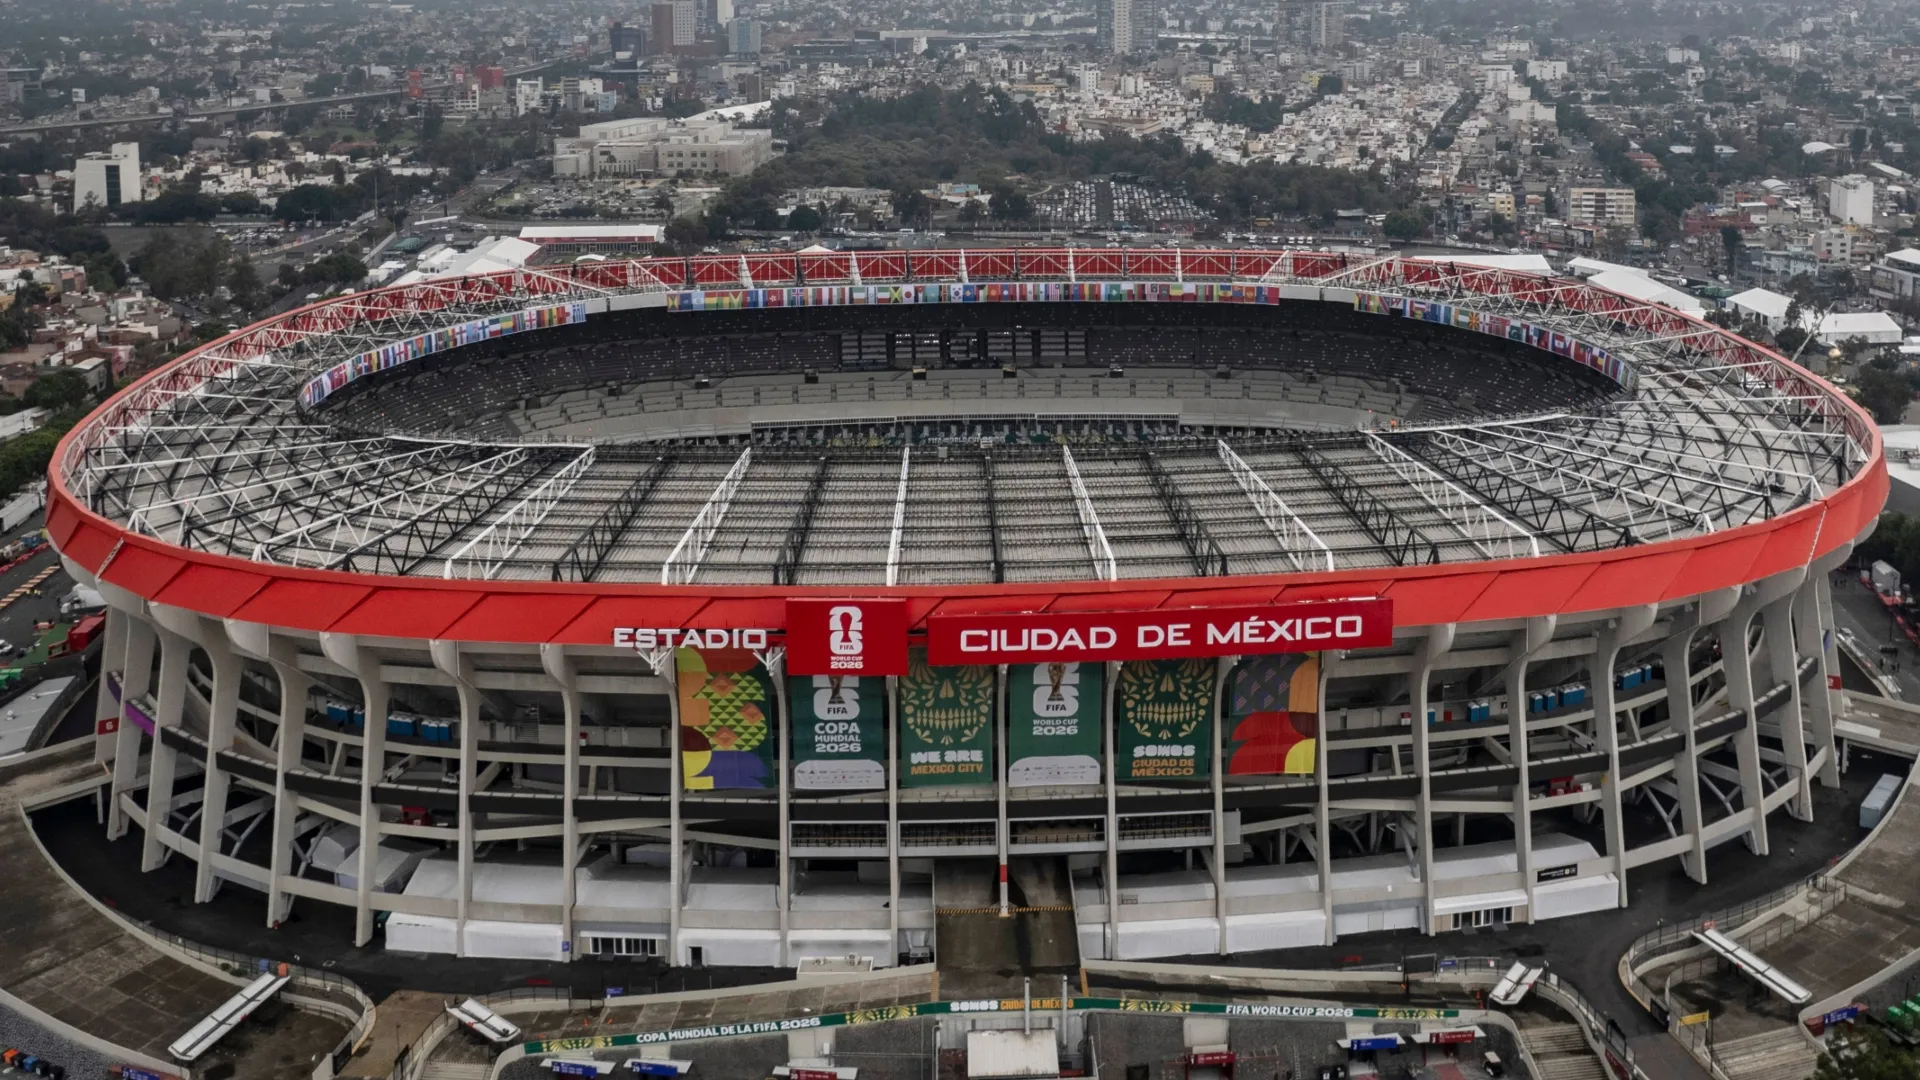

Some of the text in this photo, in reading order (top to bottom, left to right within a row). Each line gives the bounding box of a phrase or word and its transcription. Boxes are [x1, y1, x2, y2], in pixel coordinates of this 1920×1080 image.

[613, 627, 767, 649] ESTADIO
[960, 615, 1363, 652] CIUDAD DE MÉXICO
[830, 661, 864, 669] 2026
[827, 706, 848, 714] FIFA
[1046, 704, 1067, 712] FIFA
[814, 722, 861, 734] COPA
[1032, 726, 1079, 735] 2026
[814, 734, 861, 743] MUNDIAL
[815, 743, 862, 753] 2026
[1133, 744, 1196, 758] SOMOS
[910, 751, 941, 764] WE
[1132, 758, 1194, 768] CIUDAD DE
[911, 763, 983, 776] MEXICO CITY
[950, 1000, 998, 1012] SOMOS
[1000, 1000, 1025, 1010] CIUDA
[1031, 999, 1041, 1009] DE
[1226, 1005, 1354, 1018] FIFA WORLD CUP 2026
[636, 1017, 821, 1043] COPA MUNDIAL DE LA FIFA 2026
